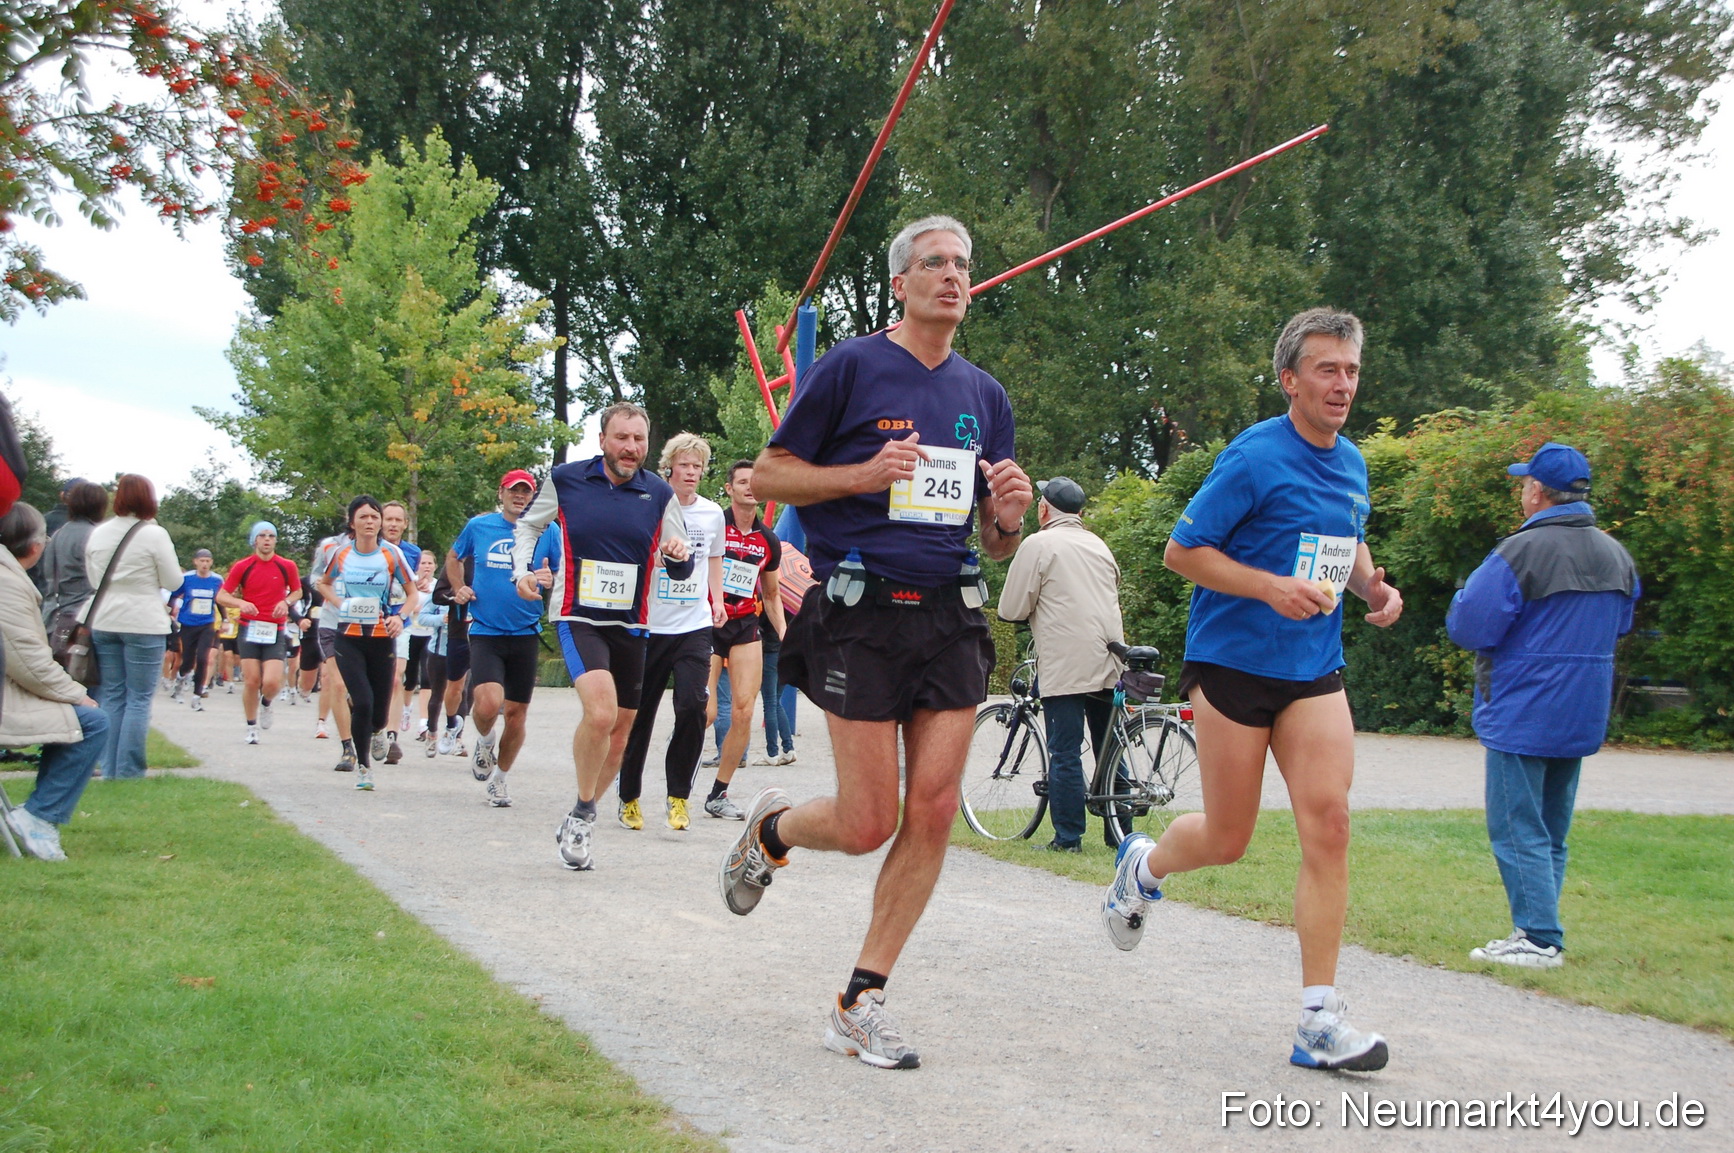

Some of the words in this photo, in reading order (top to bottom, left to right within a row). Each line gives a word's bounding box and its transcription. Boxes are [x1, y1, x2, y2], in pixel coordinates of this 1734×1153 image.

[877, 419, 914, 430] OBI
[923, 477, 961, 500] 245
[1320, 543, 1351, 558] Andreas
[597, 565, 624, 577] Thomas
[1300, 560, 1307, 571] B
[730, 572, 753, 586] 2074
[601, 580, 625, 595] 781
[672, 583, 698, 593] 2247
[351, 604, 375, 614] 3522
